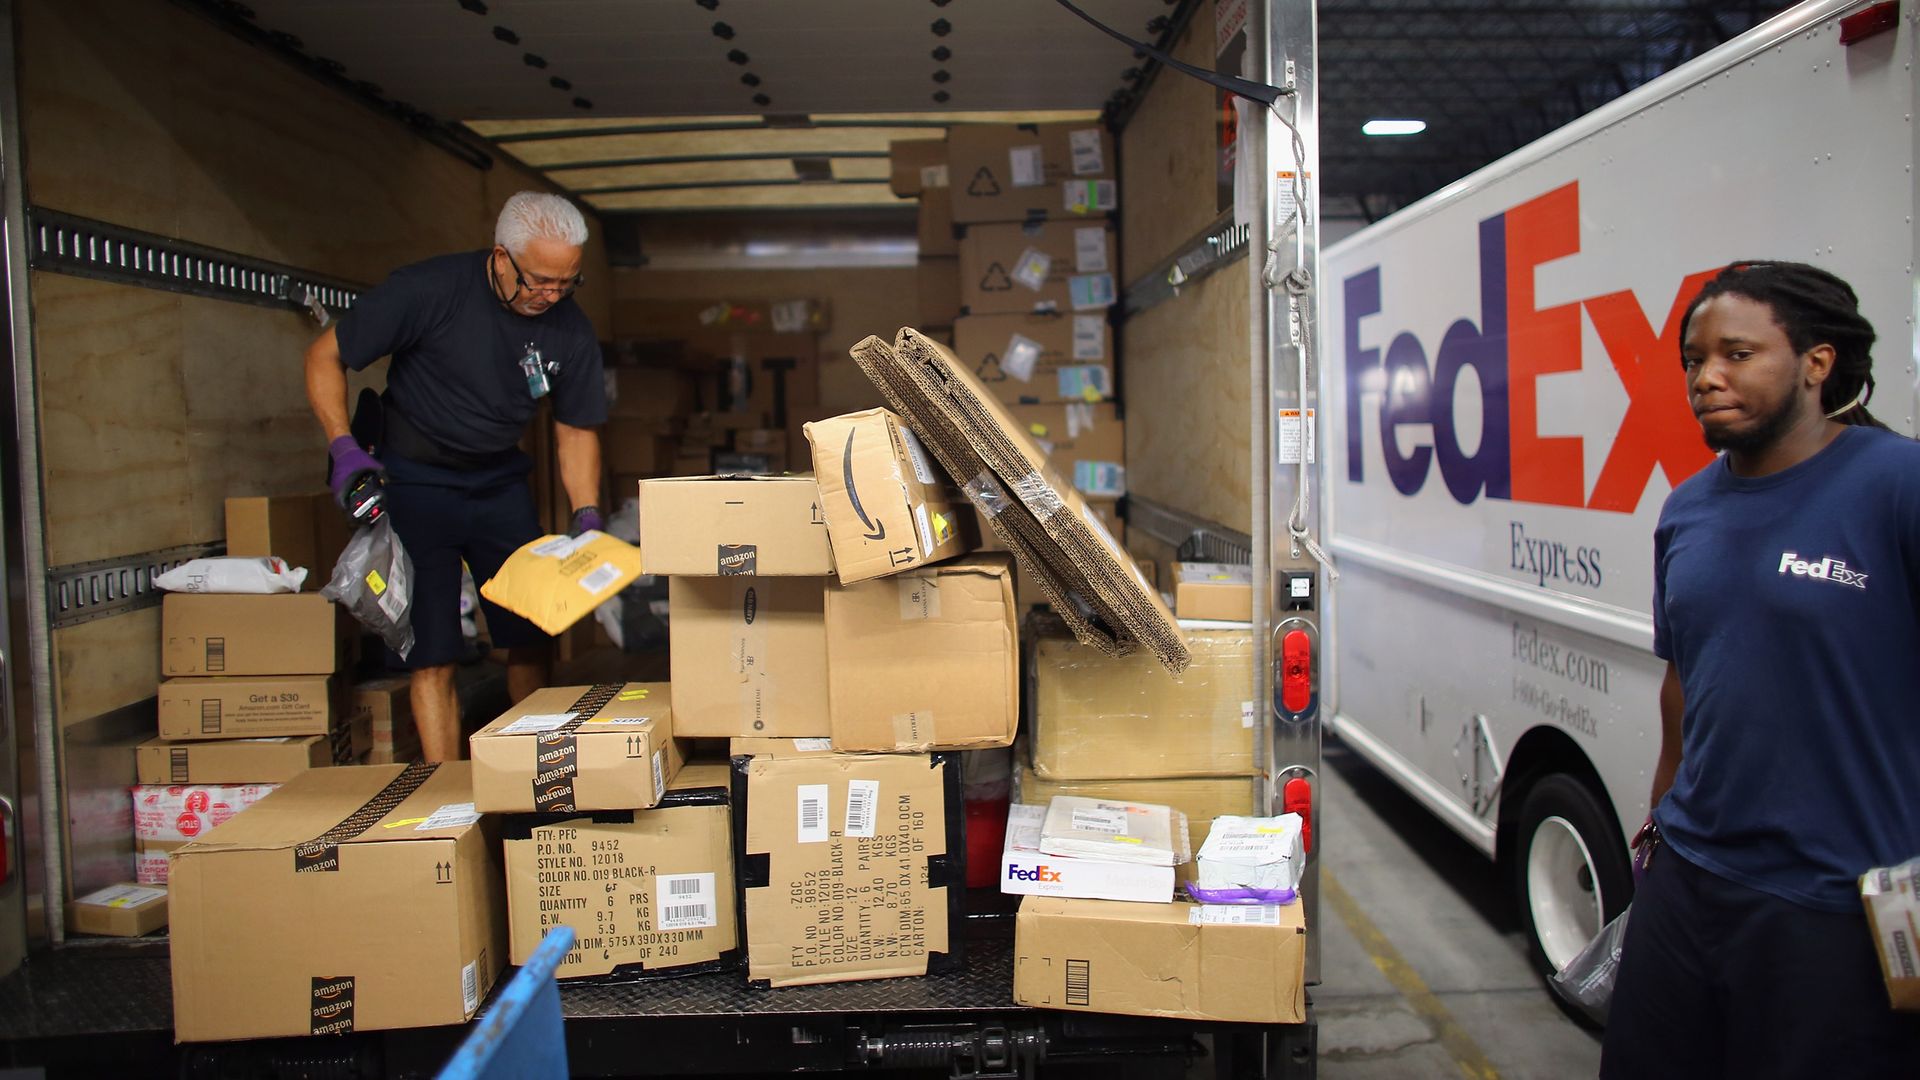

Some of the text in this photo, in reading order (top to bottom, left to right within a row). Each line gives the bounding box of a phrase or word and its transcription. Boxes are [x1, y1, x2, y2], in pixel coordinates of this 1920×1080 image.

[1344, 180, 1749, 514] FedEx
[720, 550, 755, 566] amazon
[1510, 520, 1601, 588] Express
[1778, 553, 1868, 588] FedEx
[1512, 621, 1608, 694] fedex.com
[249, 694, 268, 702] Get
[280, 693, 299, 702] $30
[539, 744, 576, 762] amazon
[540, 764, 576, 778] amazon
[536, 786, 572, 804] amazon
[913, 812, 923, 830] 160
[537, 829, 577, 841] FTY: PFC
[537, 840, 619, 855] P.O. NO. 9452
[858, 837, 870, 870] PAIRS
[913, 838, 924, 851] OF
[298, 859, 336, 872] amazon
[538, 853, 624, 869] STYLE NO. 12018
[539, 866, 656, 883] COLOR NO. 019 BLACK-R
[1008, 864, 1062, 883] FedEx
[539, 886, 561, 897] SIZE
[885, 835, 898, 957] N.W: 8.70 KGS
[1038, 883, 1064, 891] Express
[540, 893, 649, 911] QUANTITY 6 PRS
[872, 835, 885, 959] G.W: 12.40 KGS
[541, 908, 649, 925] G.W. 9.7 KG
[598, 924, 615, 934] 5.9
[638, 921, 651, 931] KG
[805, 925, 816, 939] NO
[859, 900, 872, 961] QUANTITY:
[914, 906, 925, 956] CARTON:
[584, 938, 605, 949] DIM.
[687, 930, 703, 941] MM
[819, 928, 830, 964] STYLE
[833, 925, 844, 963] COLOR
[900, 934, 911, 956] CTN
[640, 947, 678, 958] OF 240
[792, 946, 804, 967] FTY
[805, 943, 817, 966] P.O.
[846, 936, 858, 962] SIZE
[560, 953, 581, 965] TON
[314, 980, 353, 996] amazon
[314, 1000, 352, 1016] amazon
[313, 1019, 352, 1034] amazon
